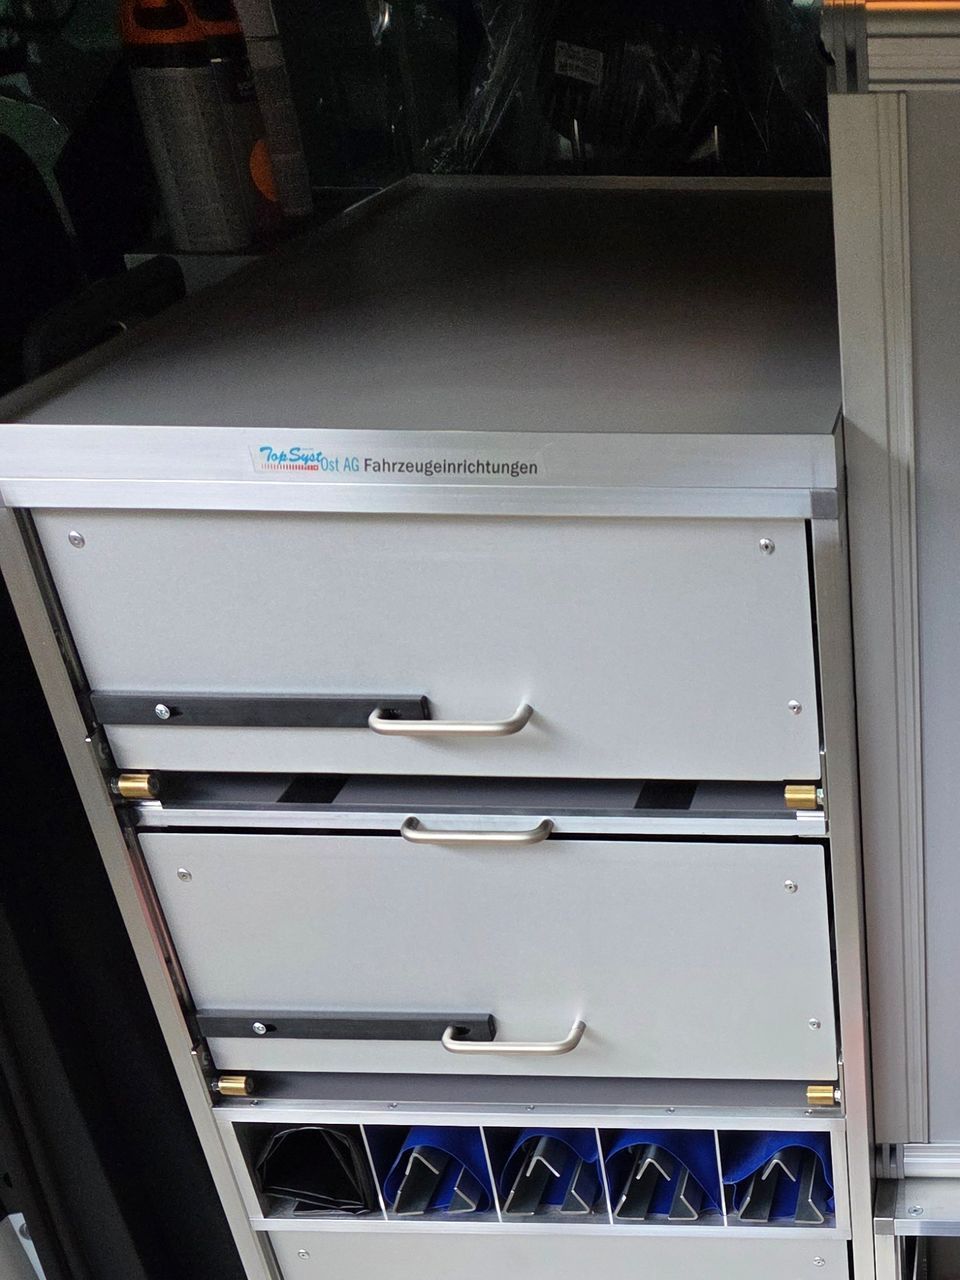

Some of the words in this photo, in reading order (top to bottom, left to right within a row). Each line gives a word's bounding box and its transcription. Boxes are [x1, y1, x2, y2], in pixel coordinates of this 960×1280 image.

[320, 456, 340, 472] Ost
[343, 458, 360, 473] AG
[364, 458, 538, 477] Fahrzeugeinrichtungen
